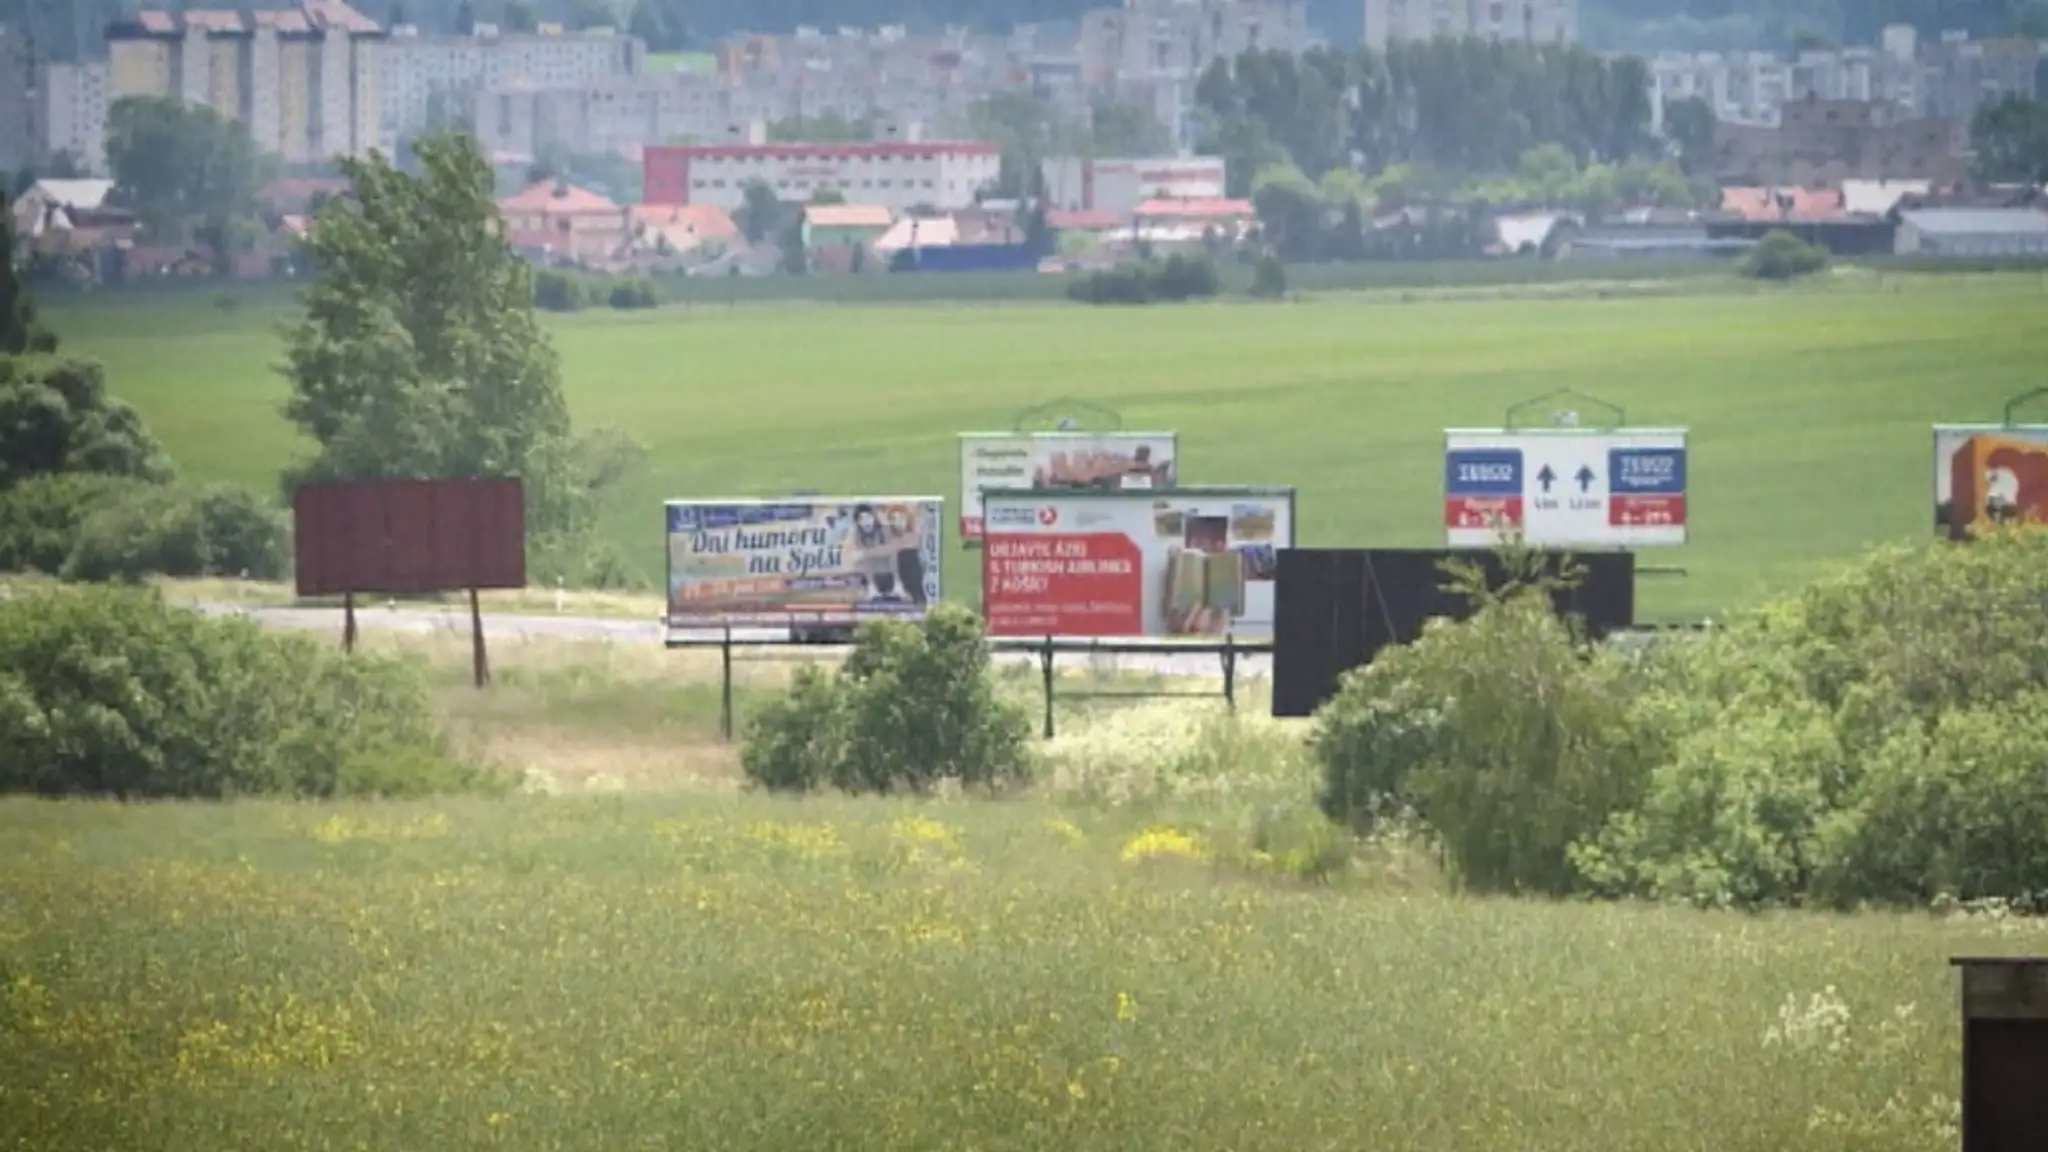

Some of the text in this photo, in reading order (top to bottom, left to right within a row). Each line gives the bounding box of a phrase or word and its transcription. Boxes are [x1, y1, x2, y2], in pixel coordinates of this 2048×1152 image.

[1457, 462, 1513, 481] TESCO
[1620, 455, 1674, 475] TESCO
[692, 527, 826, 553] Dni humoru
[749, 555, 780, 573] na
[1003, 559, 1065, 573] TURKISH
